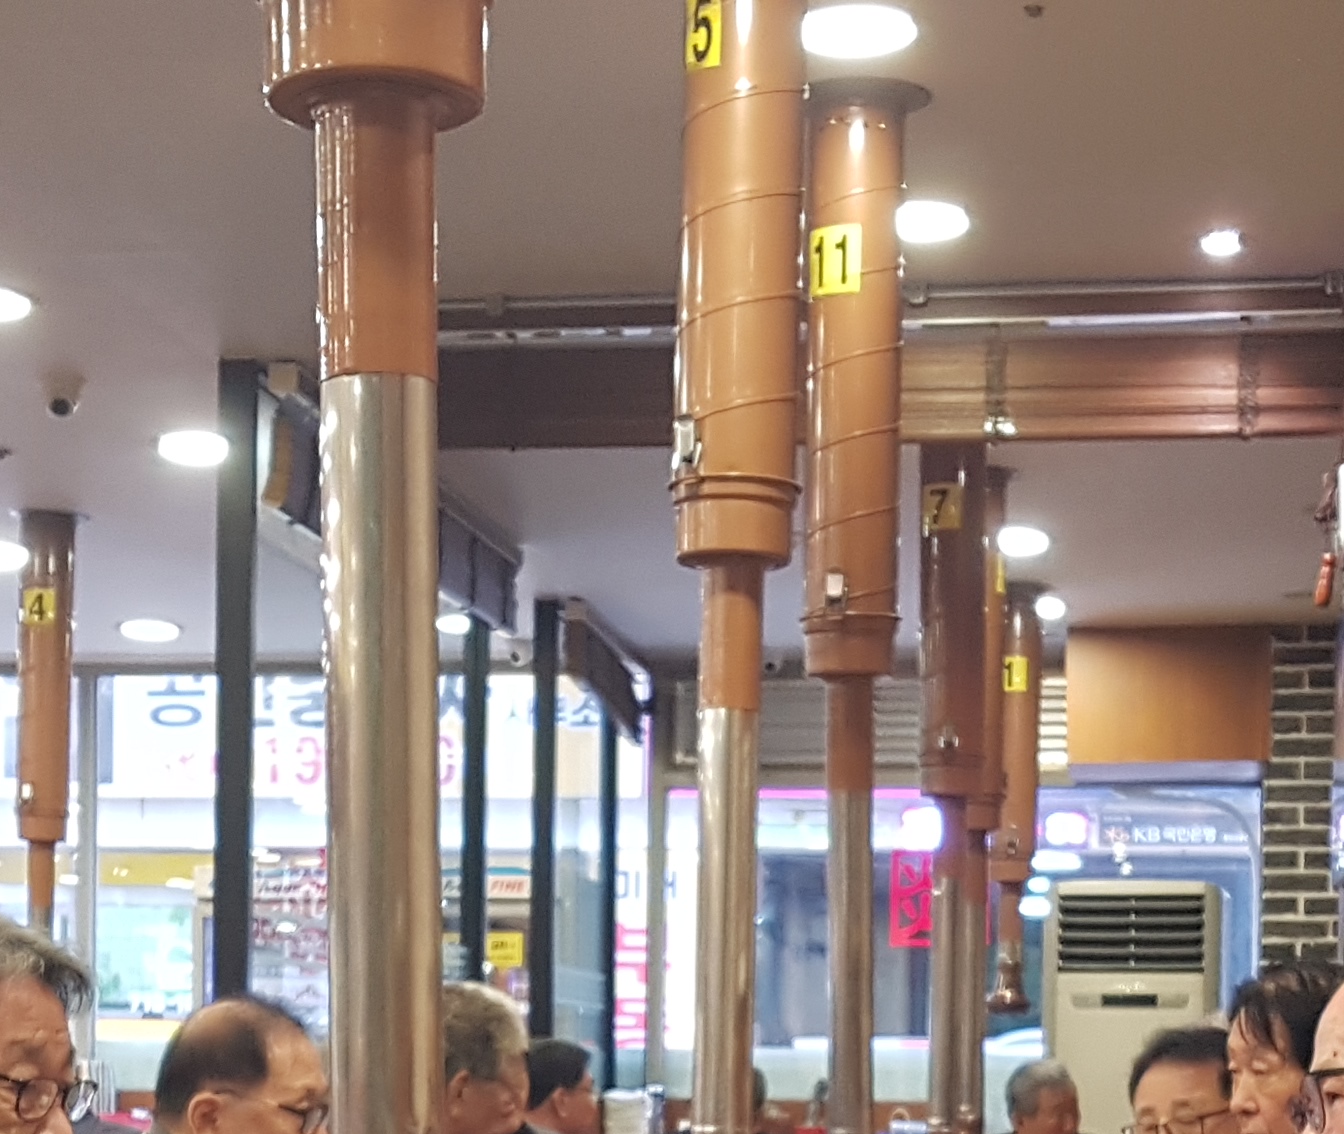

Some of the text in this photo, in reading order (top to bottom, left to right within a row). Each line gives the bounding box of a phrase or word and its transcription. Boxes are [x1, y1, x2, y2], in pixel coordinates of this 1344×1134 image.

[692, 0, 712, 62] 5
[814, 234, 847, 288] 11
[929, 488, 948, 525] 7
[29, 592, 46, 621] 4
